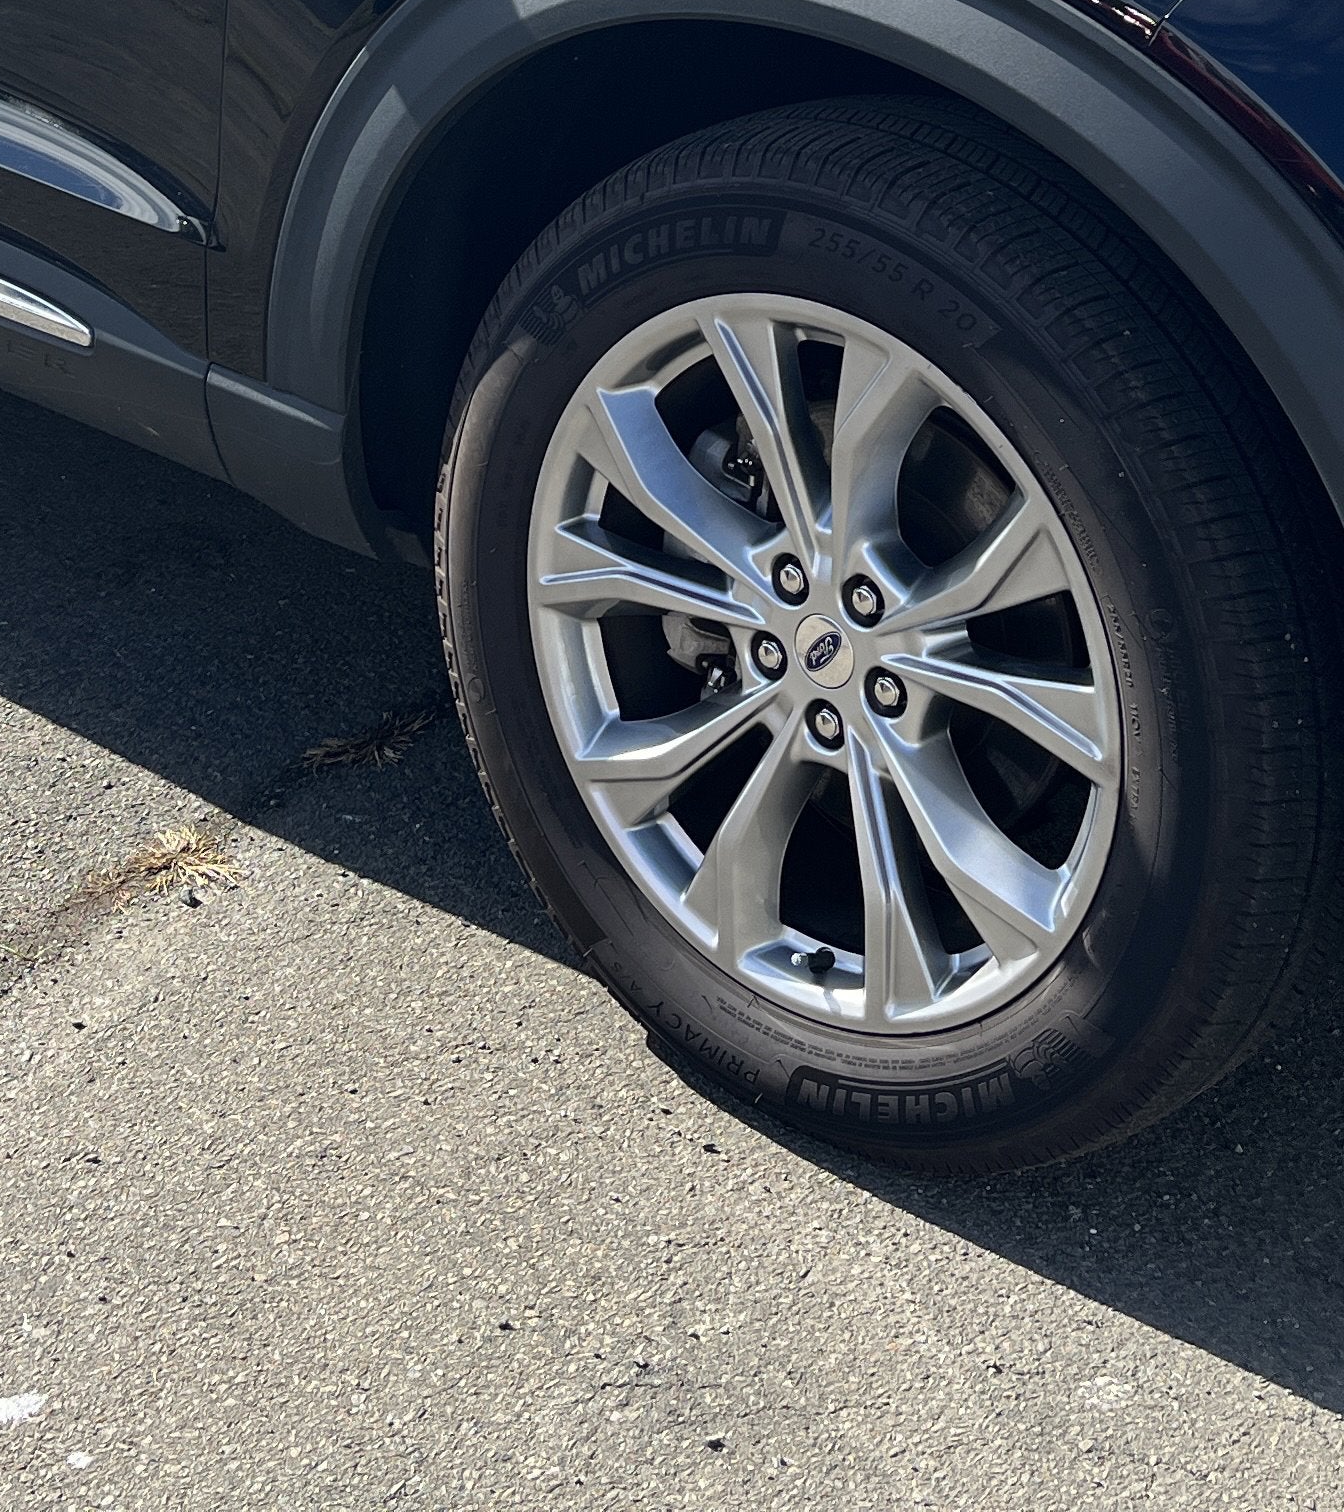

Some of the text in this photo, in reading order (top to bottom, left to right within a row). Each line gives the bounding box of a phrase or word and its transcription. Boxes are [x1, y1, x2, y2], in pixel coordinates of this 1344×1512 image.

[576, 215, 980, 333] MICHELIN 255/55 R 20
[809, 636, 834, 665] Ford
[647, 1000, 761, 1086] PRIMACY
[796, 1074, 1017, 1125] MICHELIN
